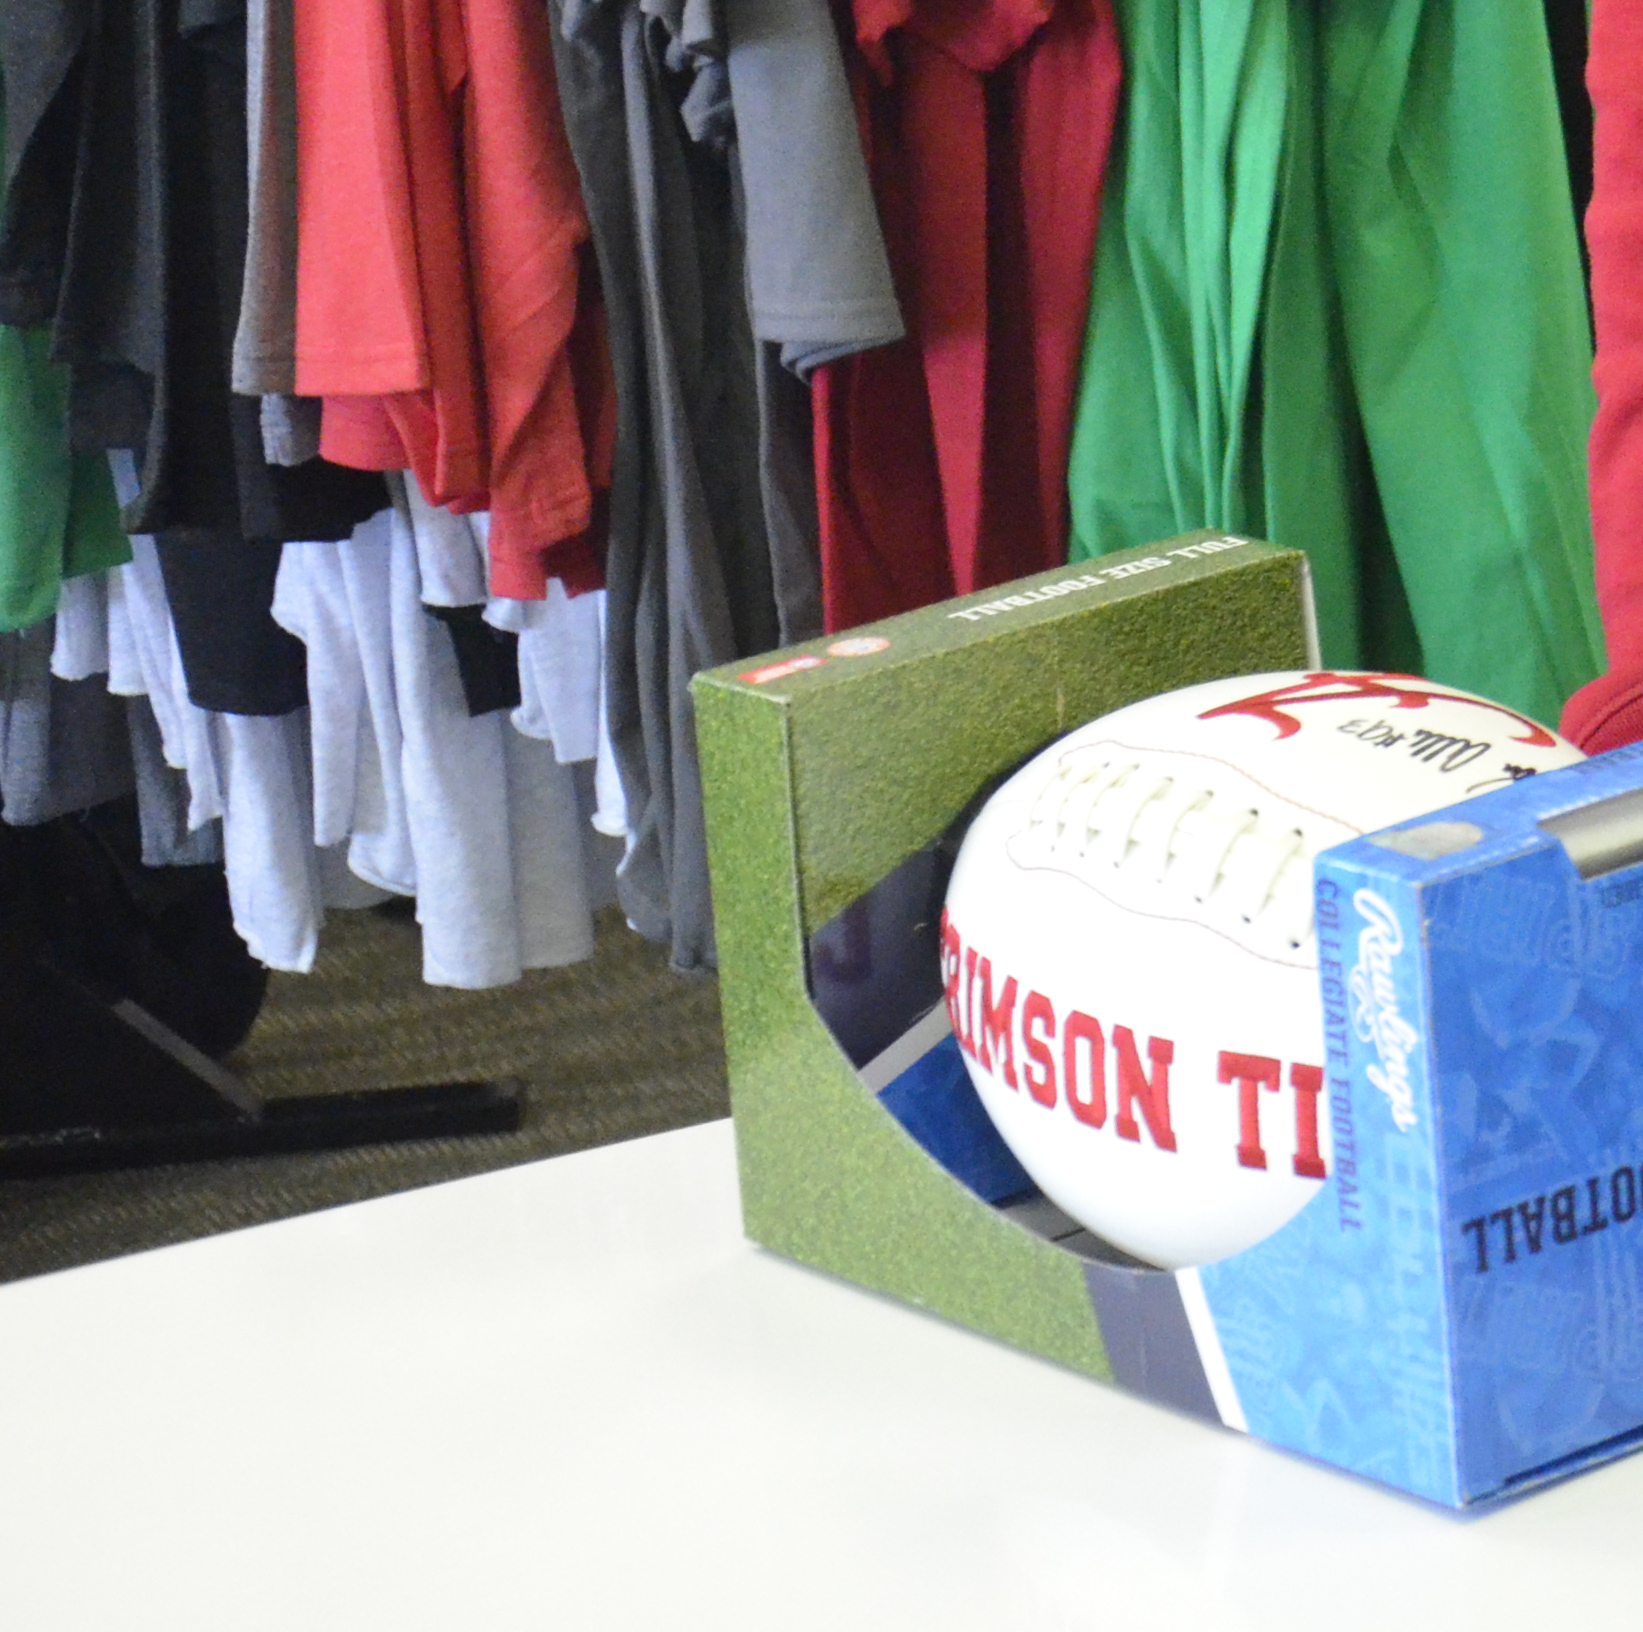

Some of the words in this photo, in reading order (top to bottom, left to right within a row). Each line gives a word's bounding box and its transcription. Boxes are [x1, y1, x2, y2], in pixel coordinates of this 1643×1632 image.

[948, 574, 1103, 622] FOOTBALL
[1099, 555, 1172, 581] SIZE
[1166, 535, 1249, 560] FULL
[939, 906, 1177, 1153] RIMSON
[1315, 877, 1349, 1070] COLLEGIATE
[1353, 887, 1419, 1133] Rawlings
[1331, 1075, 1363, 1233] FOOTBALL
